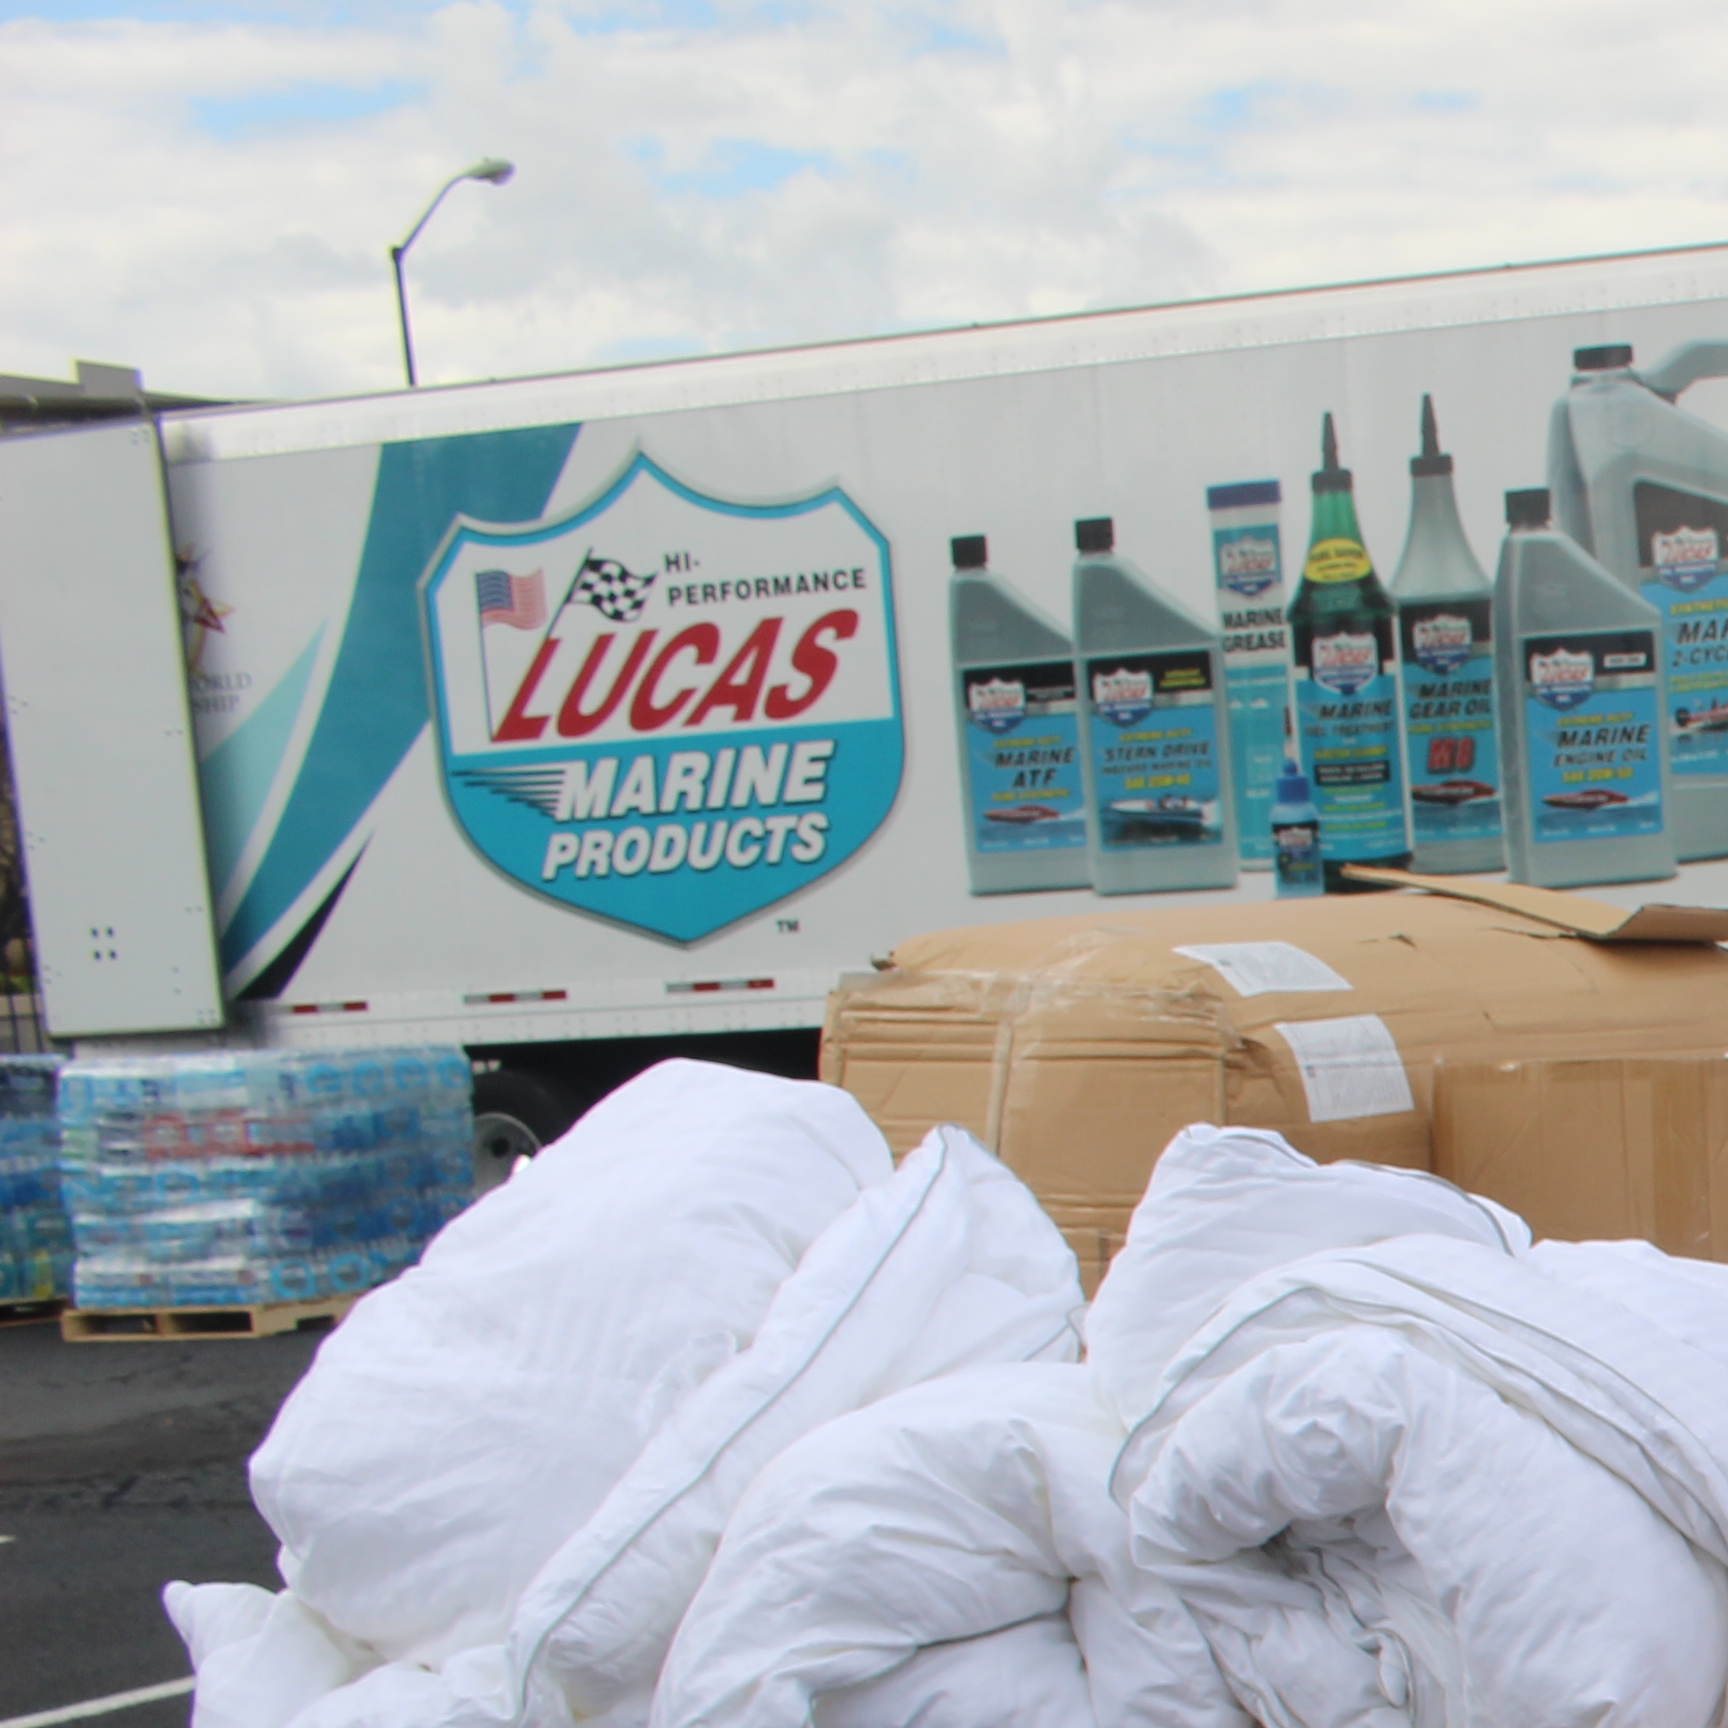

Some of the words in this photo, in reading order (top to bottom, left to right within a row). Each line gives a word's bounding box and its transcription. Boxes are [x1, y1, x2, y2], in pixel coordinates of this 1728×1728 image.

[664, 551, 701, 574] HI-
[667, 568, 867, 607] PERFORMANCE
[490, 608, 860, 744] LUCAS
[1419, 678, 1491, 699] MARINE
[1319, 700, 1393, 720] MARINE
[1409, 702, 1460, 719] GEAR
[1464, 700, 1491, 716] OIL
[1557, 725, 1650, 748] MARINE
[994, 747, 1075, 768] MARINE
[1104, 745, 1156, 763] STERN
[1162, 741, 1210, 758] DRIVE
[1553, 749, 1617, 768] ENGINE
[1623, 748, 1648, 763] OIL
[554, 738, 836, 823] MARINE
[1013, 768, 1057, 789] ATF
[541, 812, 830, 882] PRODUCTS
